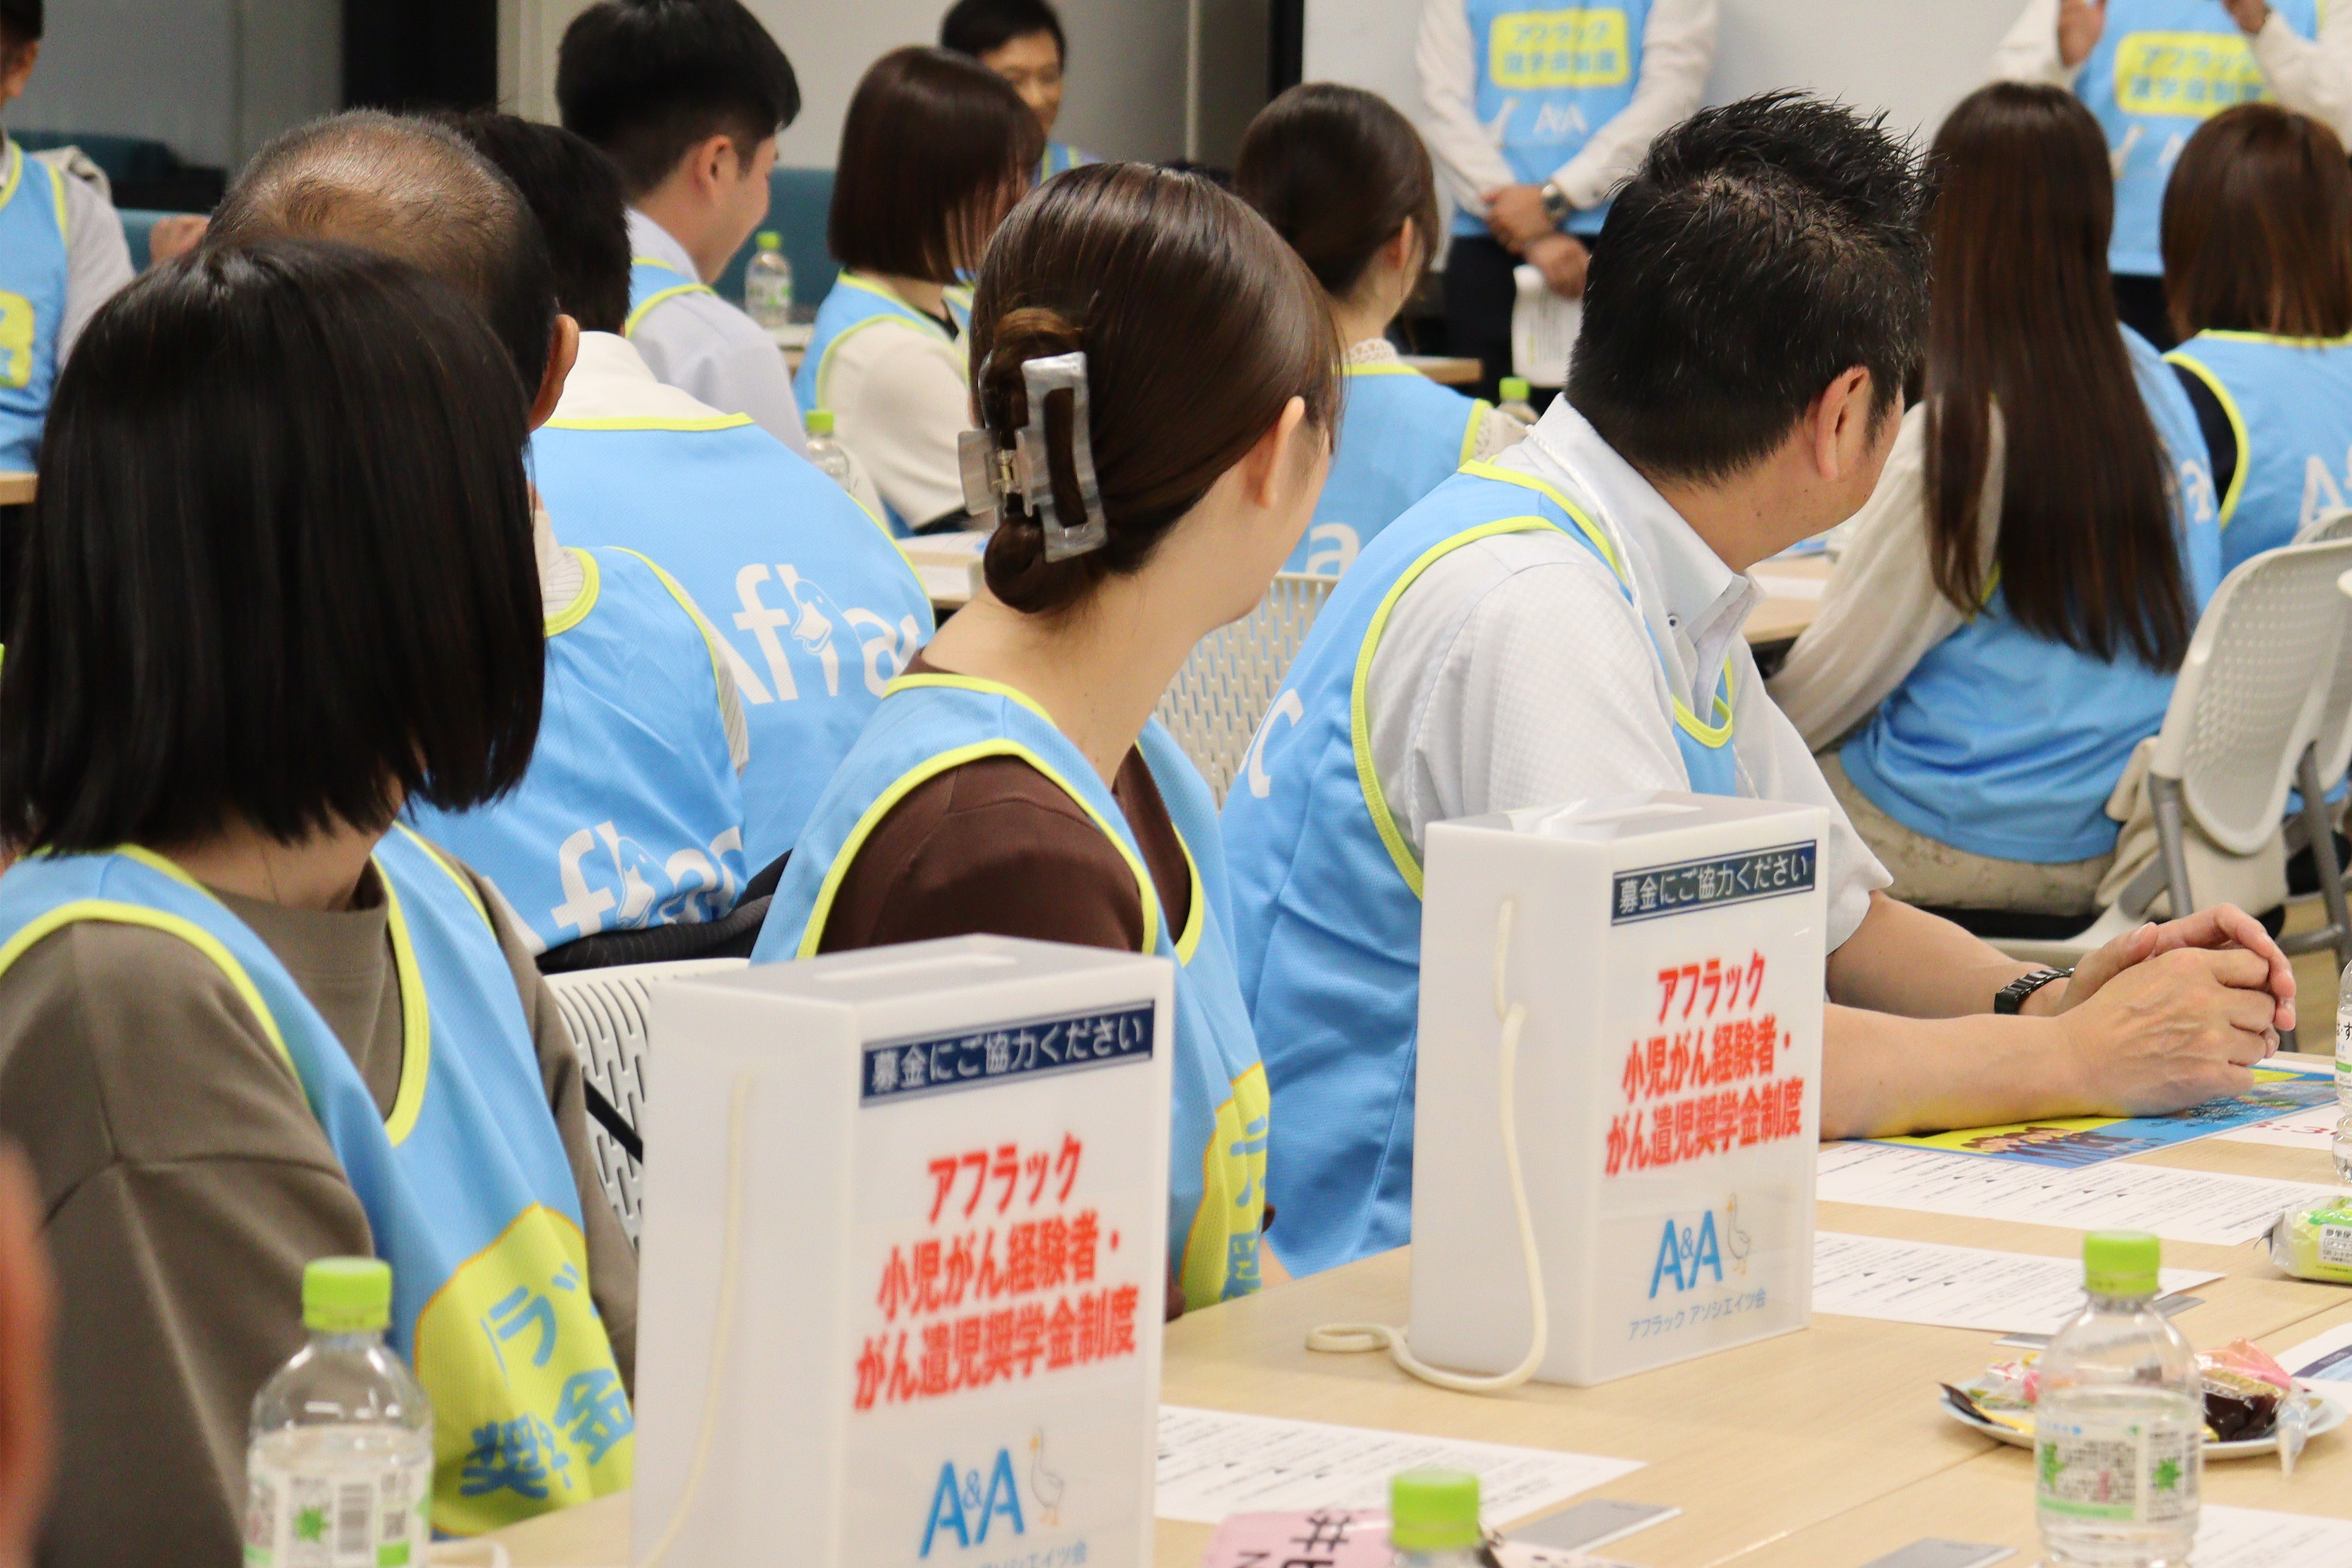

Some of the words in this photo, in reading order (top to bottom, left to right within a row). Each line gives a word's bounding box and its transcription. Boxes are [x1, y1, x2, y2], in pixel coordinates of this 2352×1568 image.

[1619, 853, 1807, 914] 募金にご協力ください
[1658, 948, 1766, 1025] アフラック
[872, 1015, 1144, 1093] 募金にご協力ください
[1605, 1076, 1804, 1178] がん遺児奨学金制度
[928, 1132, 1081, 1225] アフラック
[1649, 1210, 1724, 1299] A&A
[854, 1284, 1140, 1412] がん遺児奨学金制度
[1628, 1309, 1685, 1341] アフラック
[919, 1448, 1025, 1559] A&A
